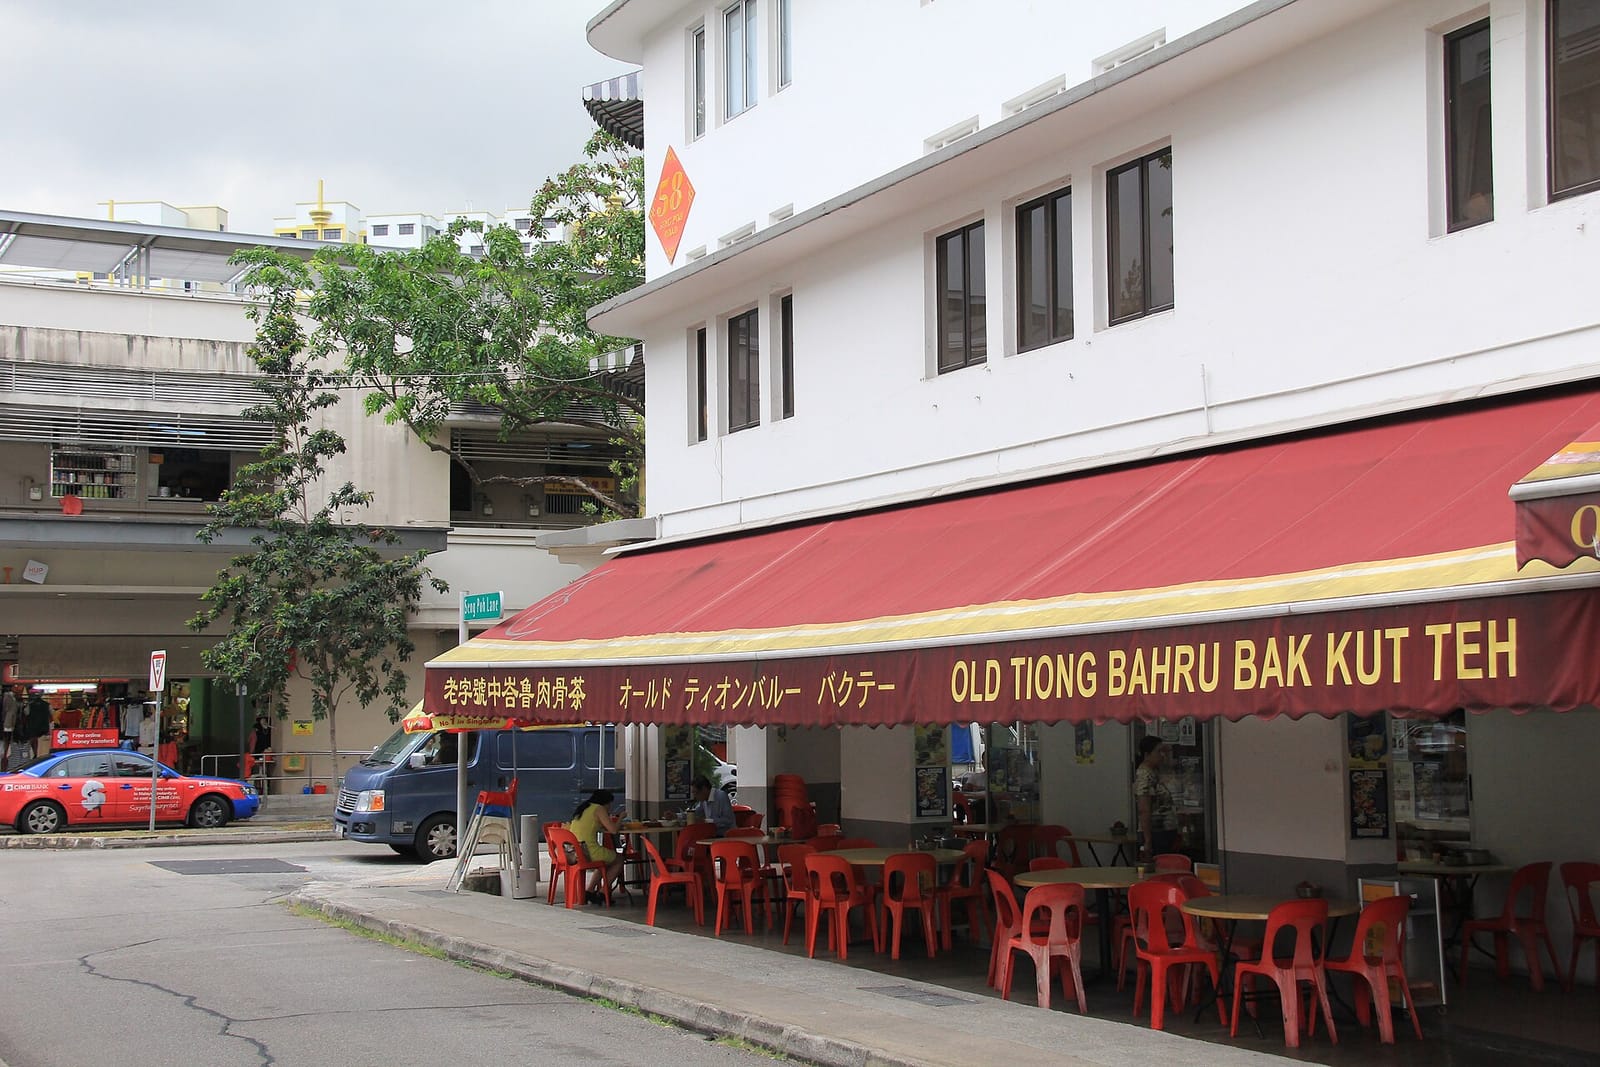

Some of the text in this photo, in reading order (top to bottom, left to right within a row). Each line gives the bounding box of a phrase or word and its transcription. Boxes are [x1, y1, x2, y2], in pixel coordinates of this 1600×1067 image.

[656, 171, 684, 217] 58
[464, 599, 476, 618] Seng
[486, 596, 499, 612] Lane
[951, 618, 1517, 703] OLD TIONG BAHRU BAK KUT TEH
[443, 675, 587, 711] 老字號中峇魯肉骨茶
[619, 670, 896, 712] オールド ティオンバルー バクテー
[467, 718, 500, 727] Singapore
